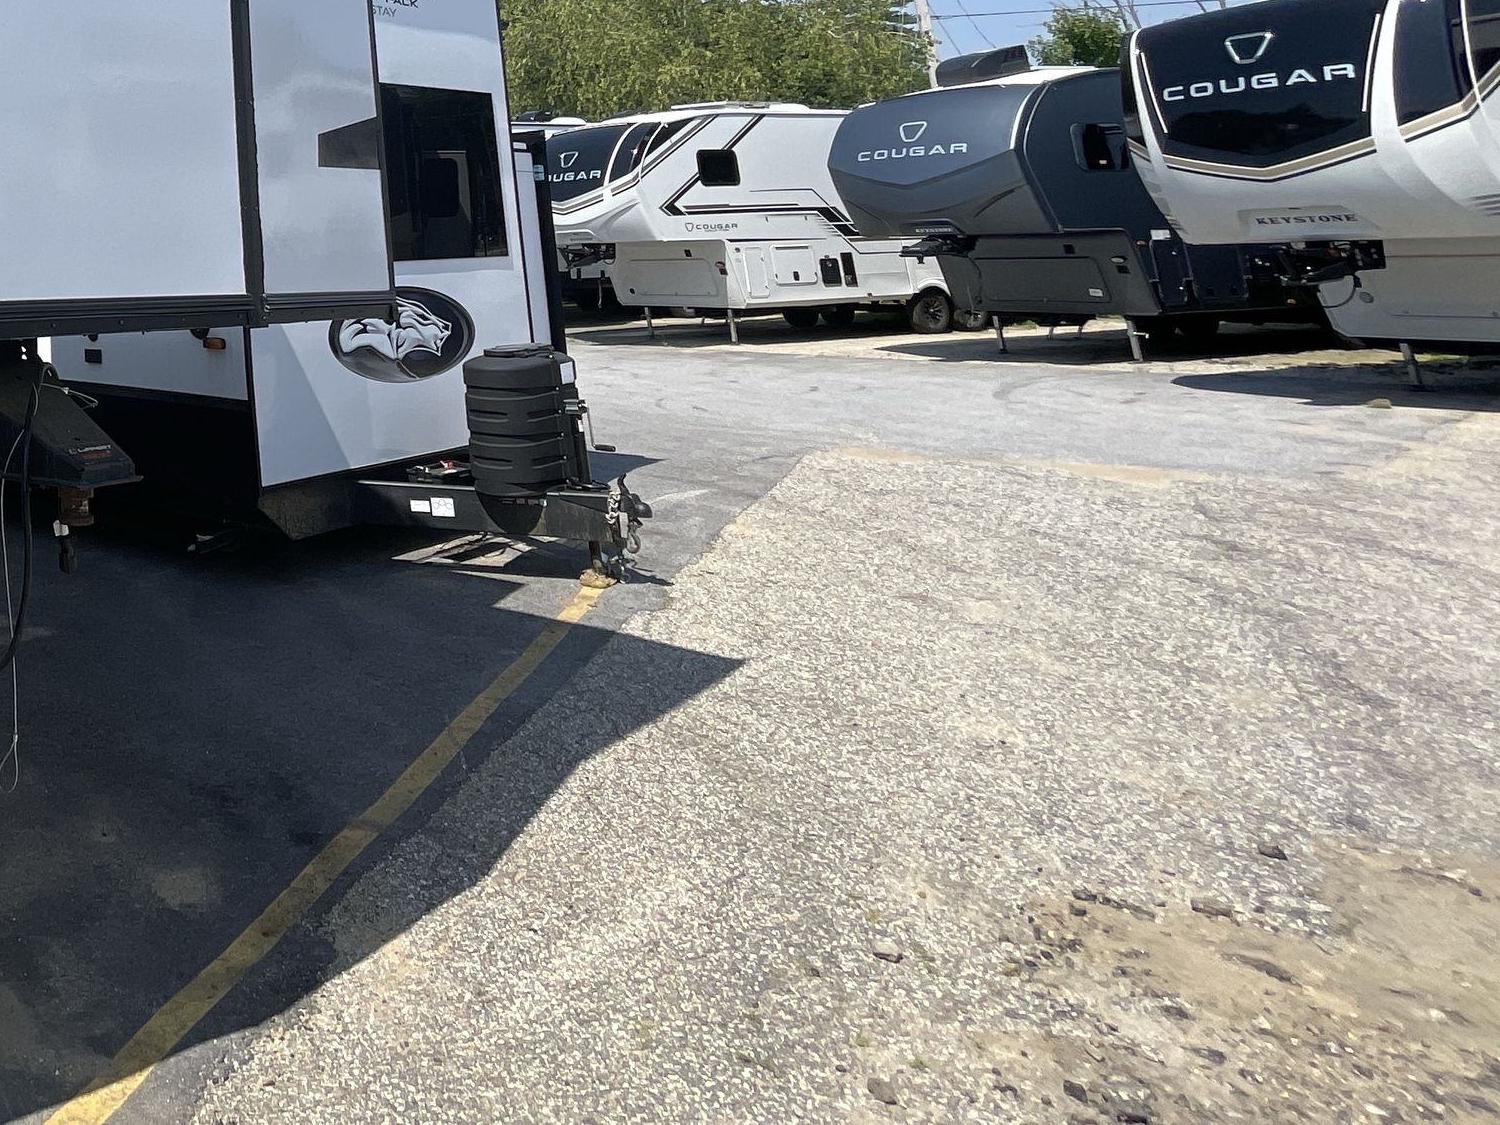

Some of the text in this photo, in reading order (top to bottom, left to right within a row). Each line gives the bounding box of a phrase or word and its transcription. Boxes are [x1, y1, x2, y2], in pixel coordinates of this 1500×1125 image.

[1162, 63, 1357, 102] COUGAR
[857, 142, 968, 162] COUGAR
[695, 222, 739, 230] COUGAR
[1254, 213, 1359, 226] KEYSTONE
